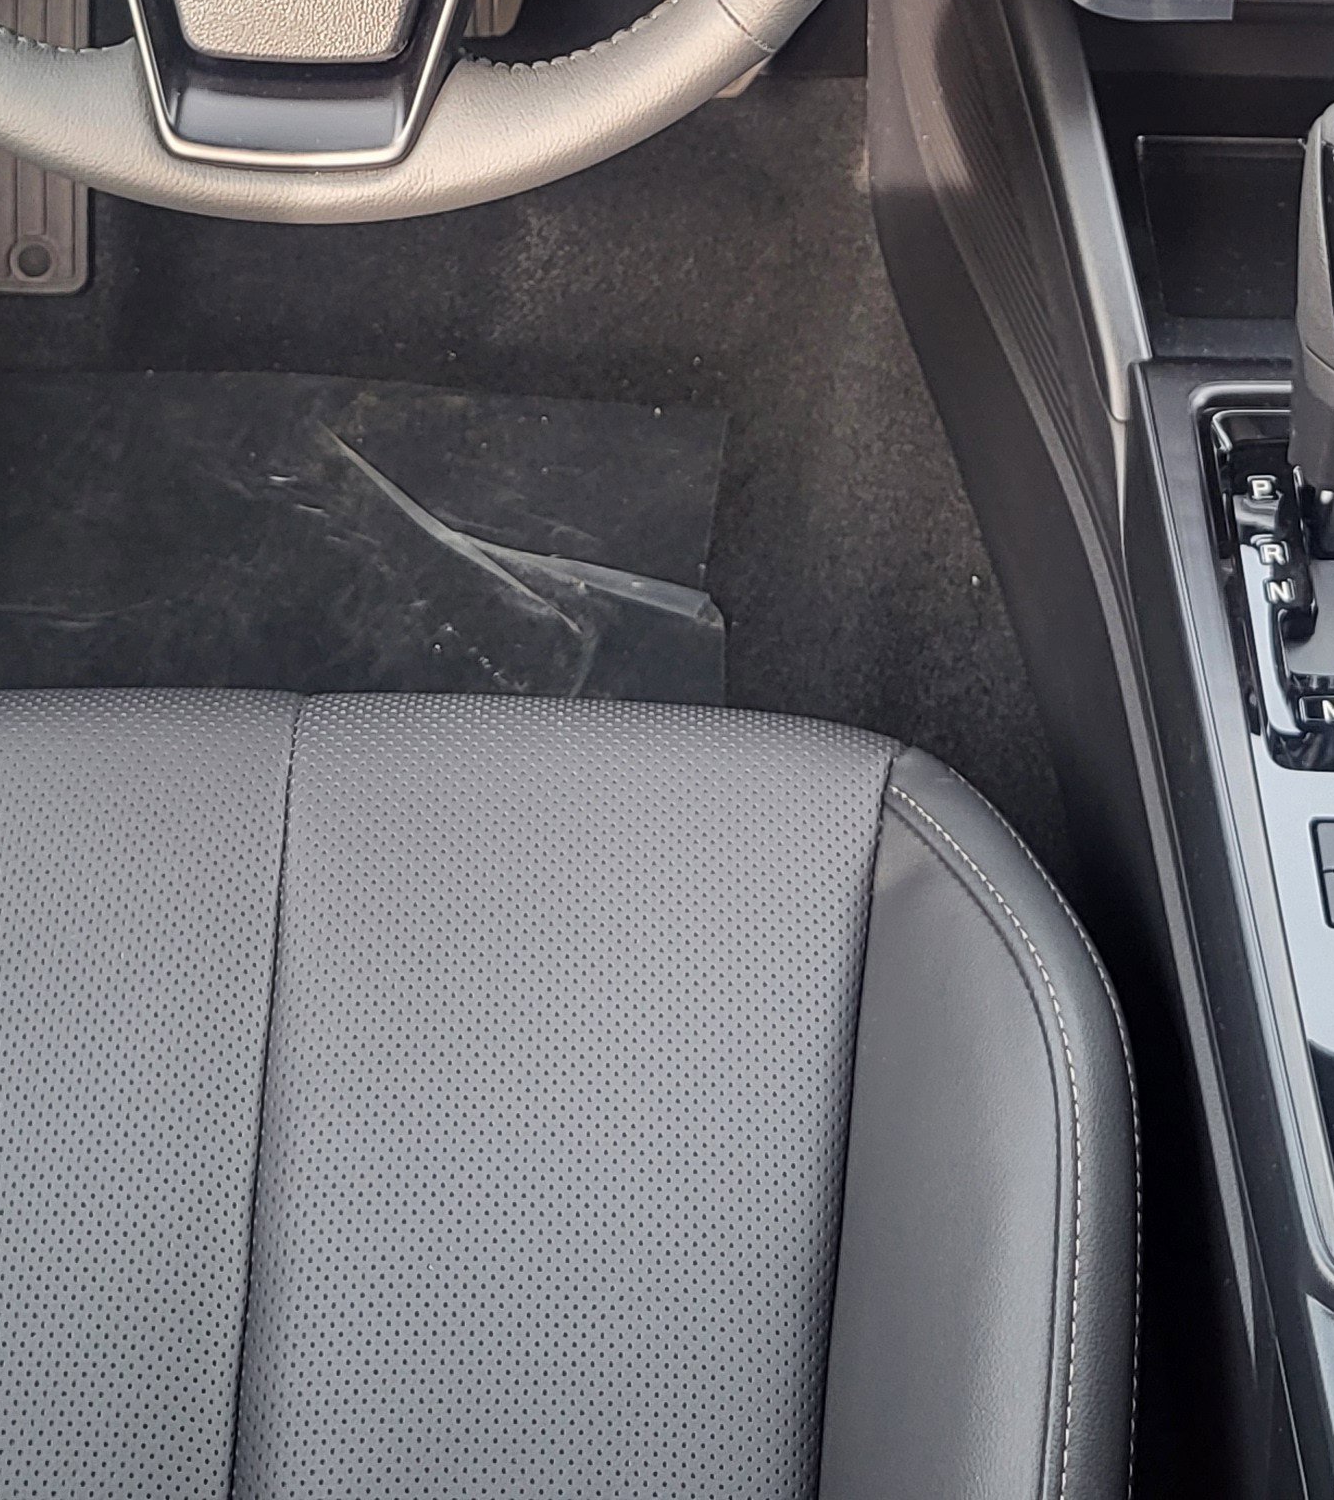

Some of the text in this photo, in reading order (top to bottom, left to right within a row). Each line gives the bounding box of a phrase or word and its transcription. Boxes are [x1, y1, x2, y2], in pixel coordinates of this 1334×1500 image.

[1251, 480, 1271, 498] P
[1264, 543, 1284, 565] R
[1269, 581, 1292, 601] N
